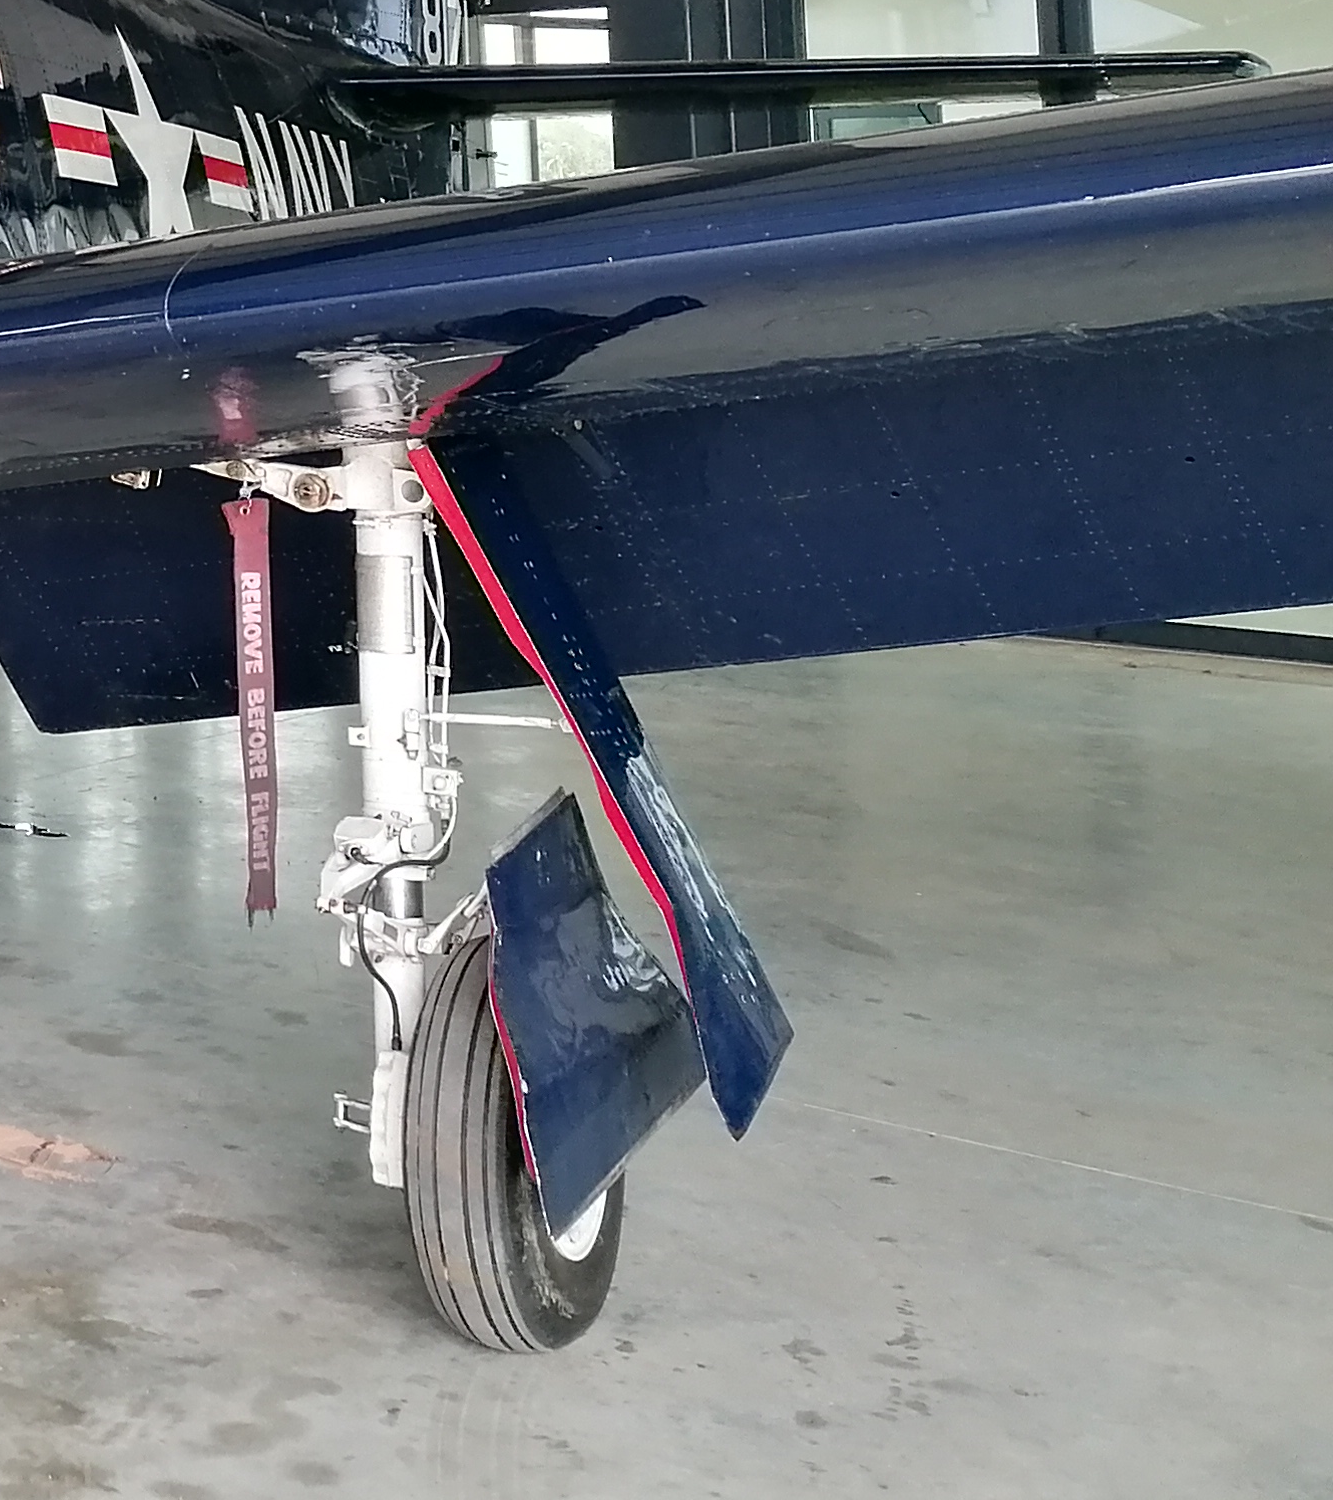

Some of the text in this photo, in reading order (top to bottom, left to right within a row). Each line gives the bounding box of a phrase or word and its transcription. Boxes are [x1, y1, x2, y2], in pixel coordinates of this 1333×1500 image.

[233, 104, 355, 220] NAVY
[240, 571, 272, 873] REMOVE BEFORE FLIGHT
